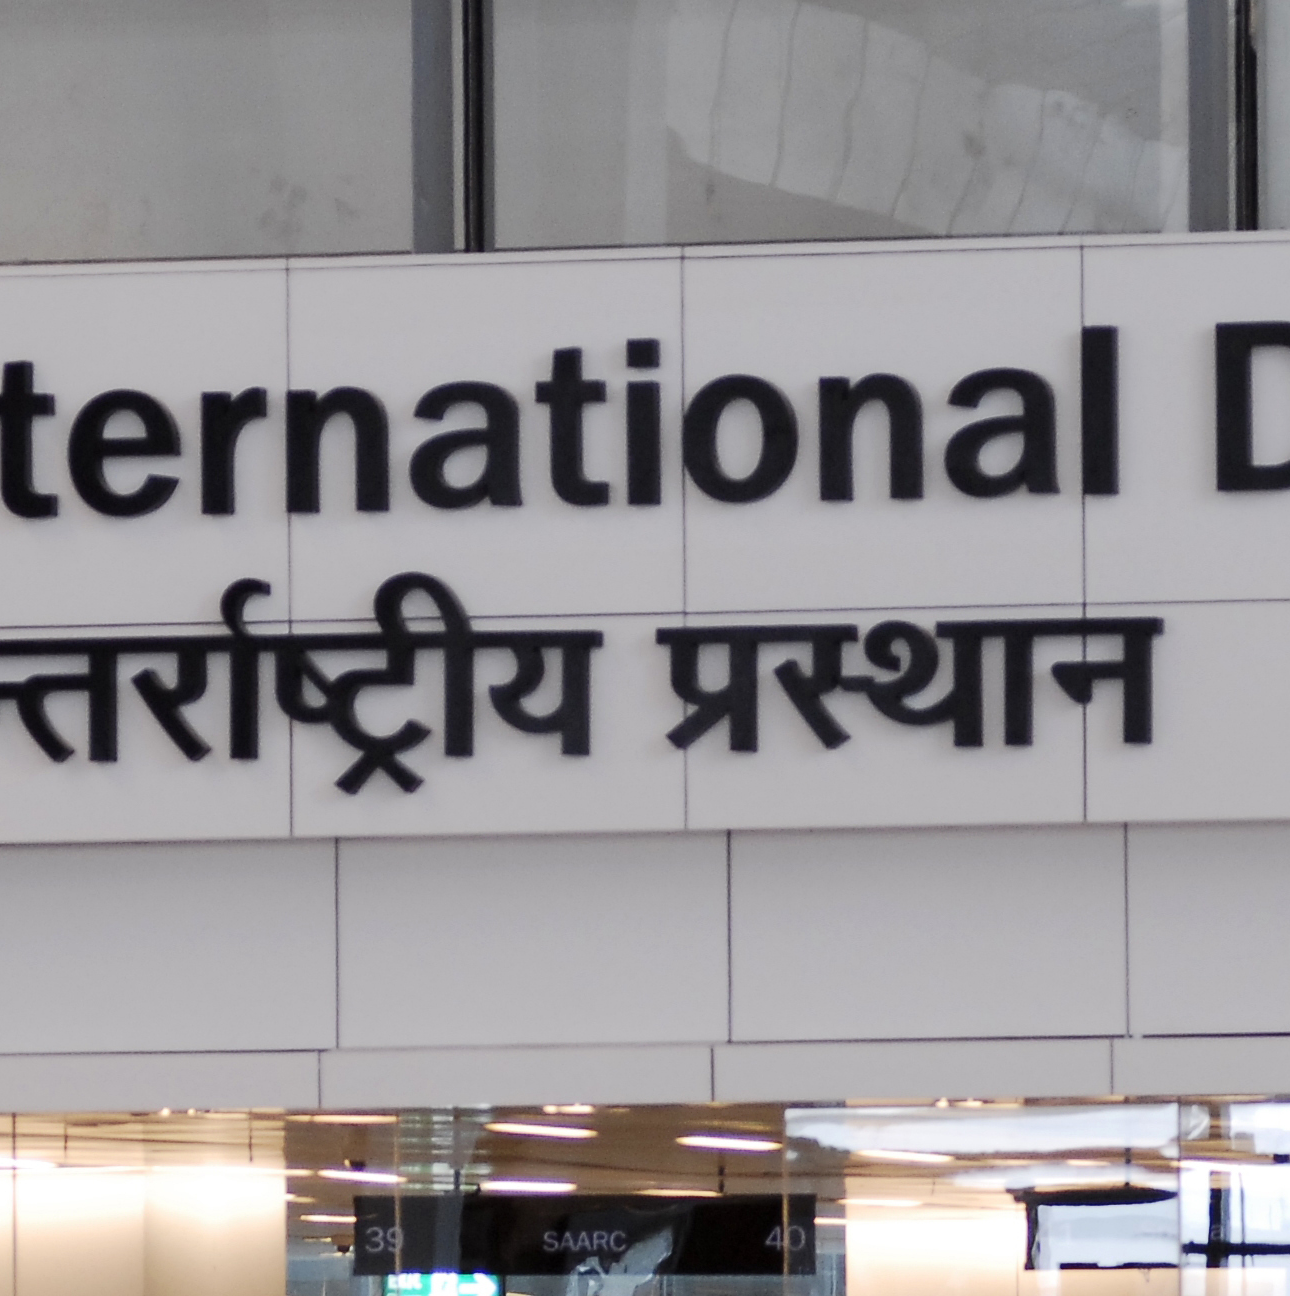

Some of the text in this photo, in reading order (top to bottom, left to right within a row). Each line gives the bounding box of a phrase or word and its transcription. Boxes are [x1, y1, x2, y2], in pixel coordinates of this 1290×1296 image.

[656, 618, 1164, 752] प्रस्थान
[365, 1227, 404, 1253] 39
[543, 1230, 626, 1252] SAARC
[765, 1225, 806, 1251] 40
